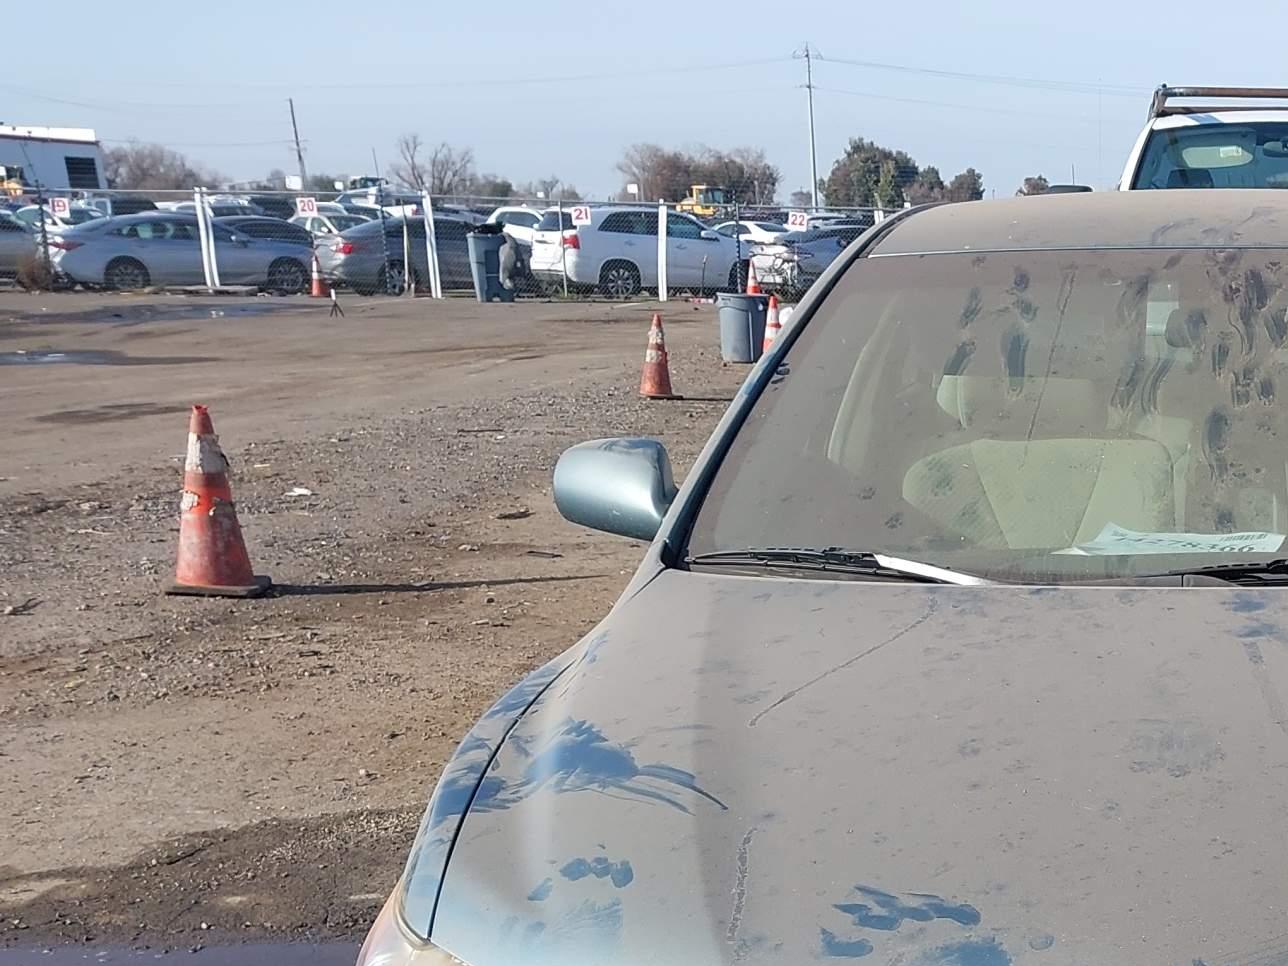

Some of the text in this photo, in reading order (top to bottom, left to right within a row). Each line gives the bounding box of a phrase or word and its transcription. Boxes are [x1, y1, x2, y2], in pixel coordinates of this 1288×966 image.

[52, 199, 66, 212] 19
[298, 199, 314, 212] 20
[573, 208, 588, 221] 21
[791, 214, 805, 226] 22
